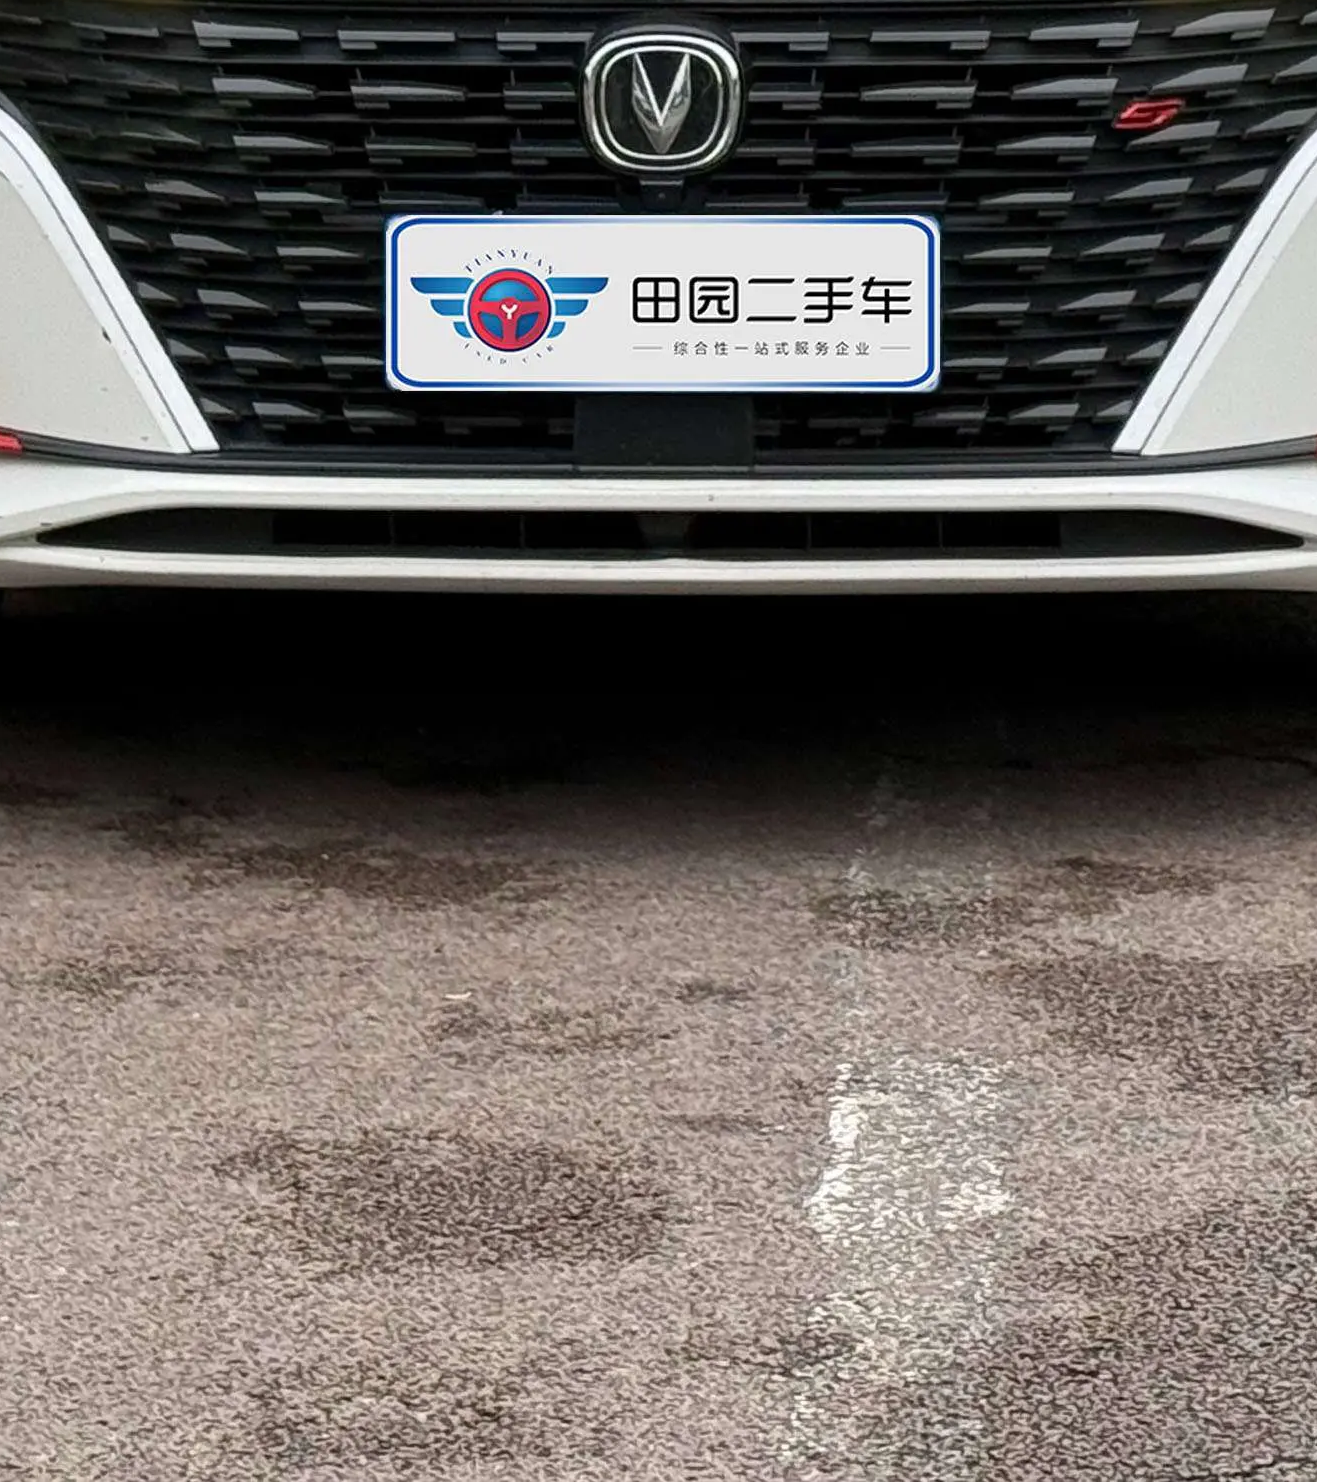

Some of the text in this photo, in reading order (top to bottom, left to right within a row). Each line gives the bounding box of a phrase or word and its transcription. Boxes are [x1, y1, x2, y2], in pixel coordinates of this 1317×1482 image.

[632, 276, 913, 324] 田园二手车
[673, 340, 871, 357] 综合性一站式服务企业
